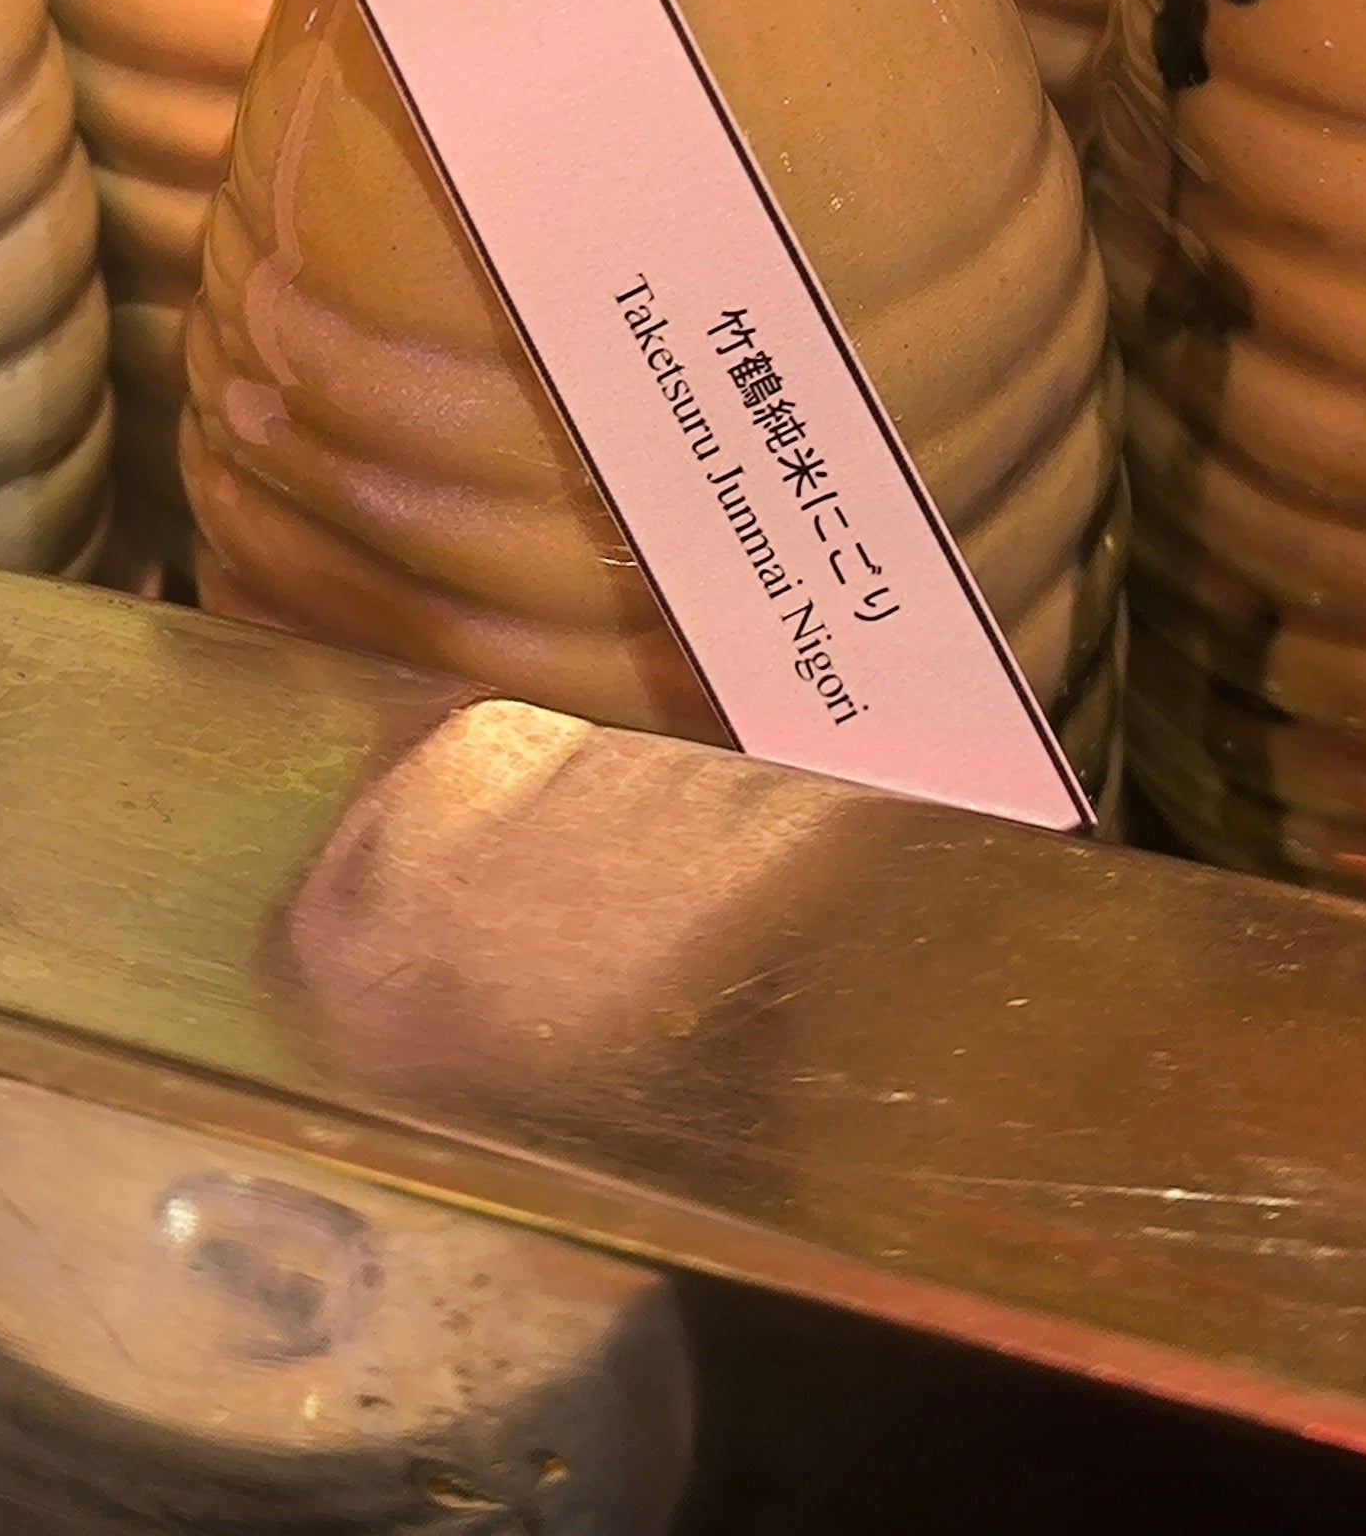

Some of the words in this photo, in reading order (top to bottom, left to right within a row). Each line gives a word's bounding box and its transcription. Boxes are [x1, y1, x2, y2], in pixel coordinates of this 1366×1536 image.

[615, 273, 722, 462] Taketsuru
[706, 464, 804, 600] Junmai
[780, 597, 869, 726] Nigori
[707, 309, 900, 622] 竹鶴純米にごり
